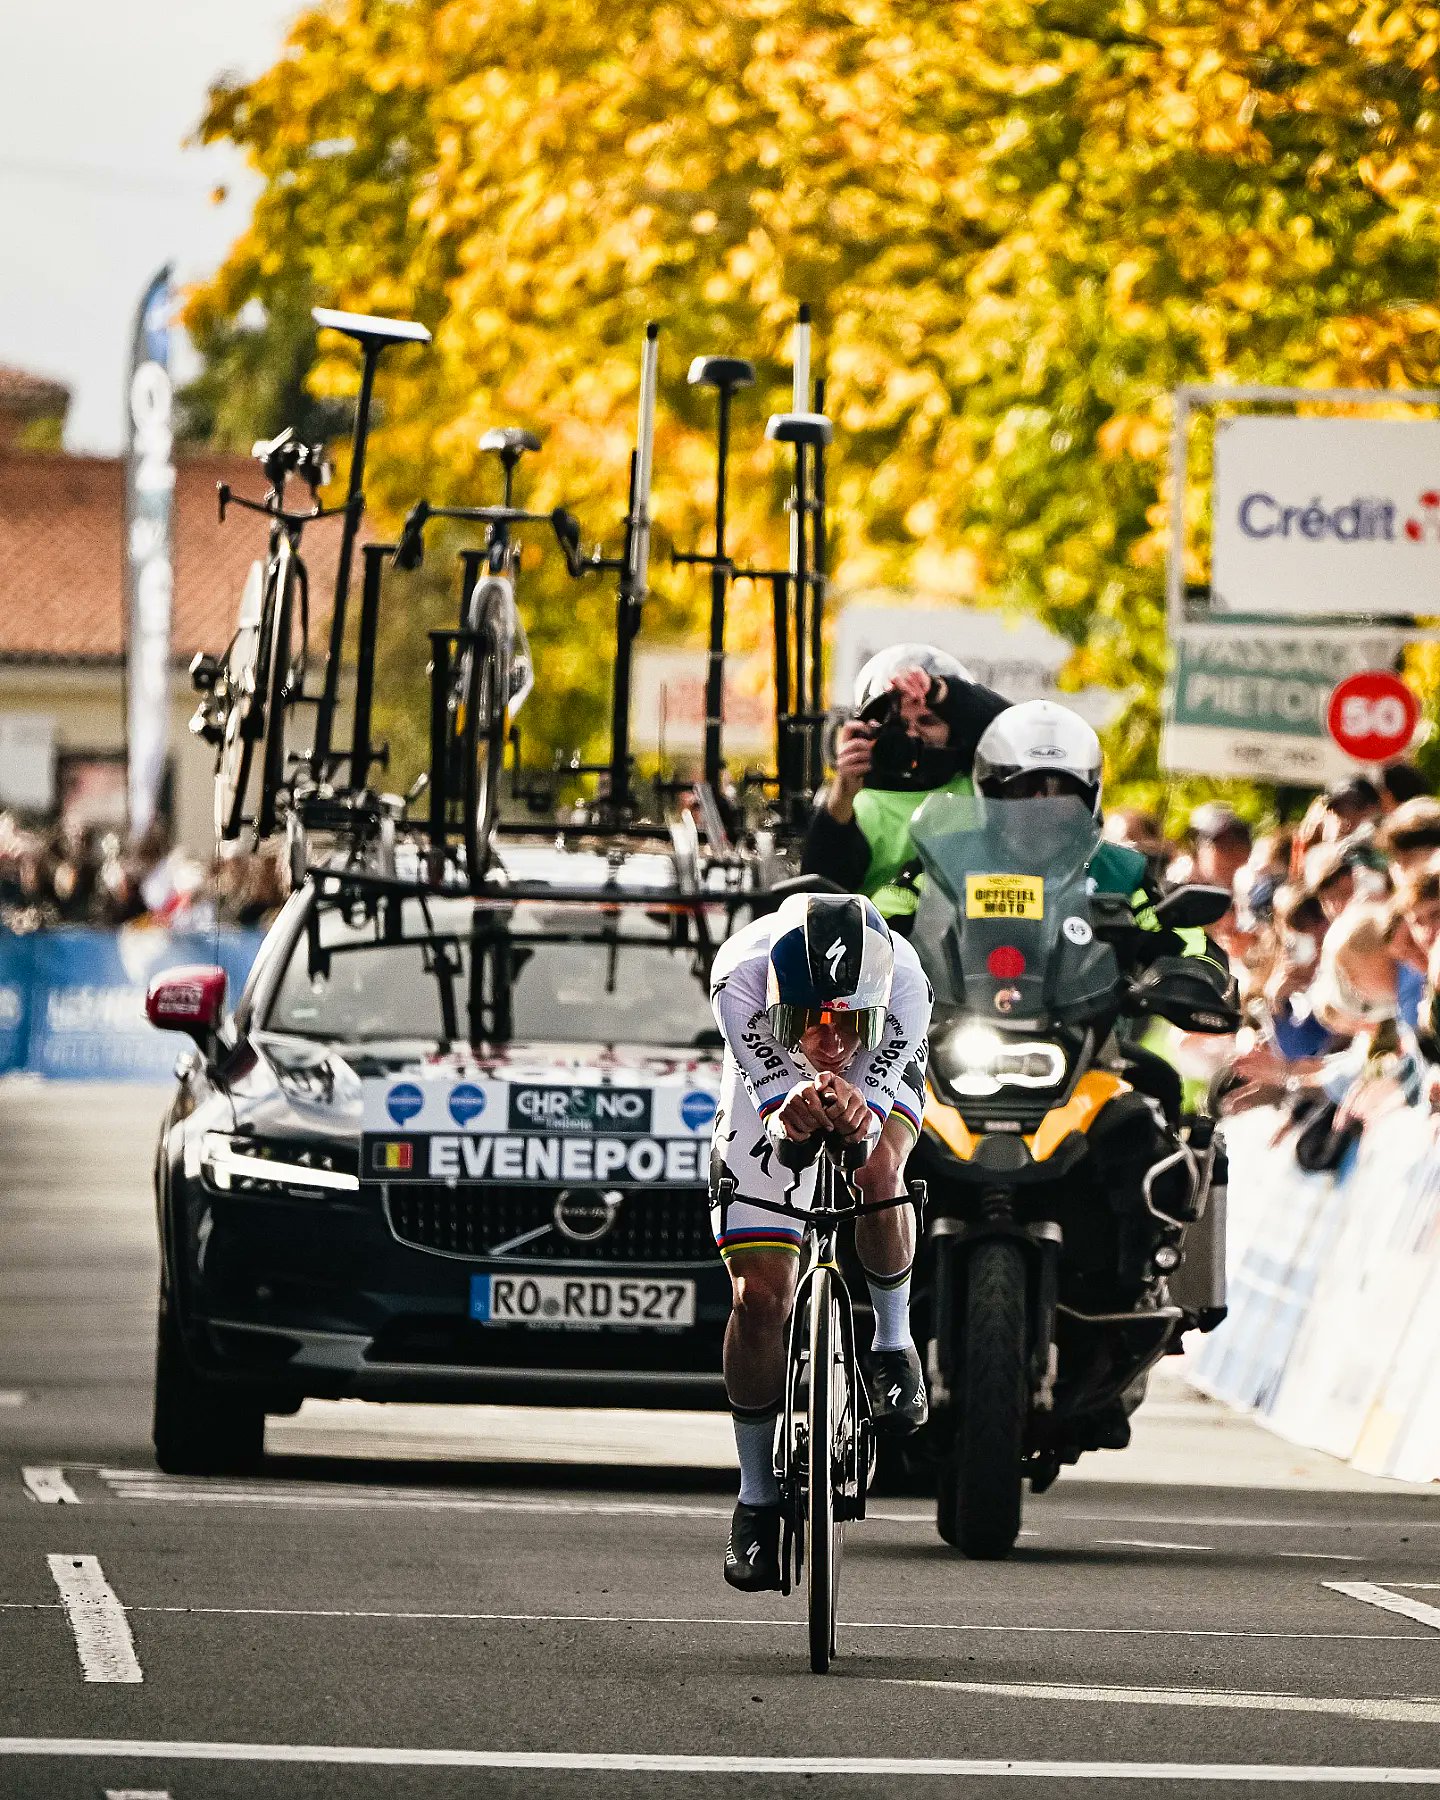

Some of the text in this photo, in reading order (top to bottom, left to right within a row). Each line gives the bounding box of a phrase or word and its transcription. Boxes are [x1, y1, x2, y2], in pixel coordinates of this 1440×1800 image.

[1238, 492, 1396, 541] Crédit
[1341, 694, 1407, 739] 50
[975, 889, 1035, 901] OFFICIEL
[984, 901, 1025, 914] MOTO
[741, 1033, 783, 1071] BOSS
[869, 1039, 909, 1078] BOSS
[493, 1279, 541, 1316] RO
